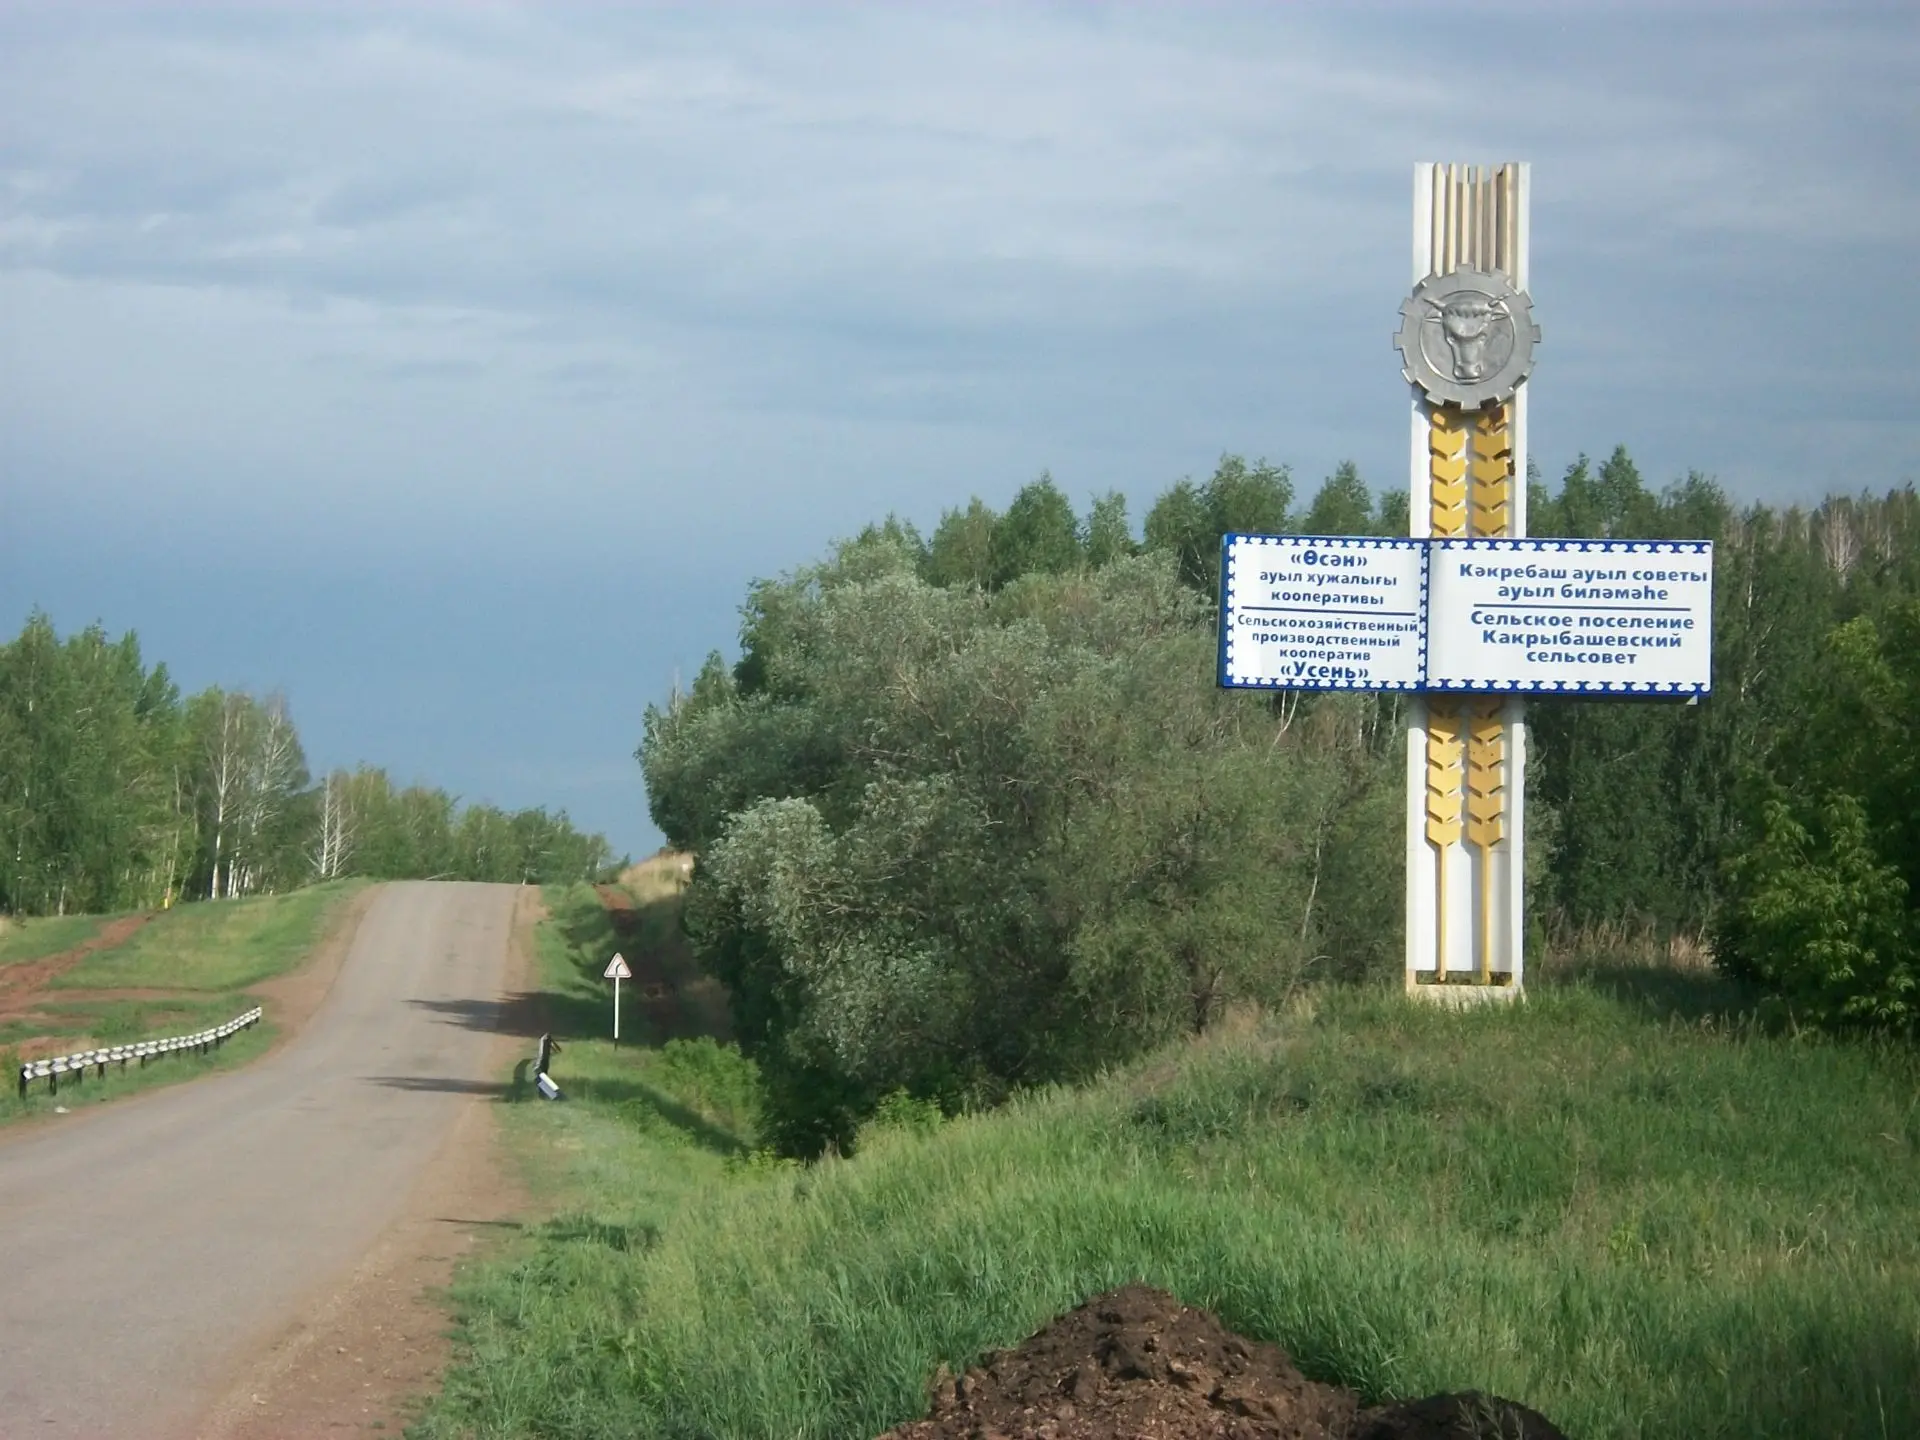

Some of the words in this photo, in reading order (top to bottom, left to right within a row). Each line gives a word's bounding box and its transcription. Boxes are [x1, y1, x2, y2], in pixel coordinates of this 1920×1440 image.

[1290, 550, 1368, 567] «Өсән»
[1259, 570, 1302, 584] ауыл
[1459, 563, 1567, 581] Кәкребаш
[1572, 568, 1626, 583] ауыл
[1632, 569, 1708, 582] советы
[1271, 591, 1384, 606] кооперативы
[1498, 584, 1554, 601] ауыл
[1560, 584, 1669, 600] биләмәһе
[1237, 614, 1418, 632] Сельскохозяйственный
[1470, 610, 1573, 627] Сельское
[1578, 615, 1695, 629] поселение
[1252, 632, 1400, 647] производственный
[1482, 630, 1682, 648] Какрыбашевский
[1279, 649, 1371, 662] кооператив
[1526, 650, 1637, 664] сельсовет
[1280, 661, 1369, 679] «Усень»
